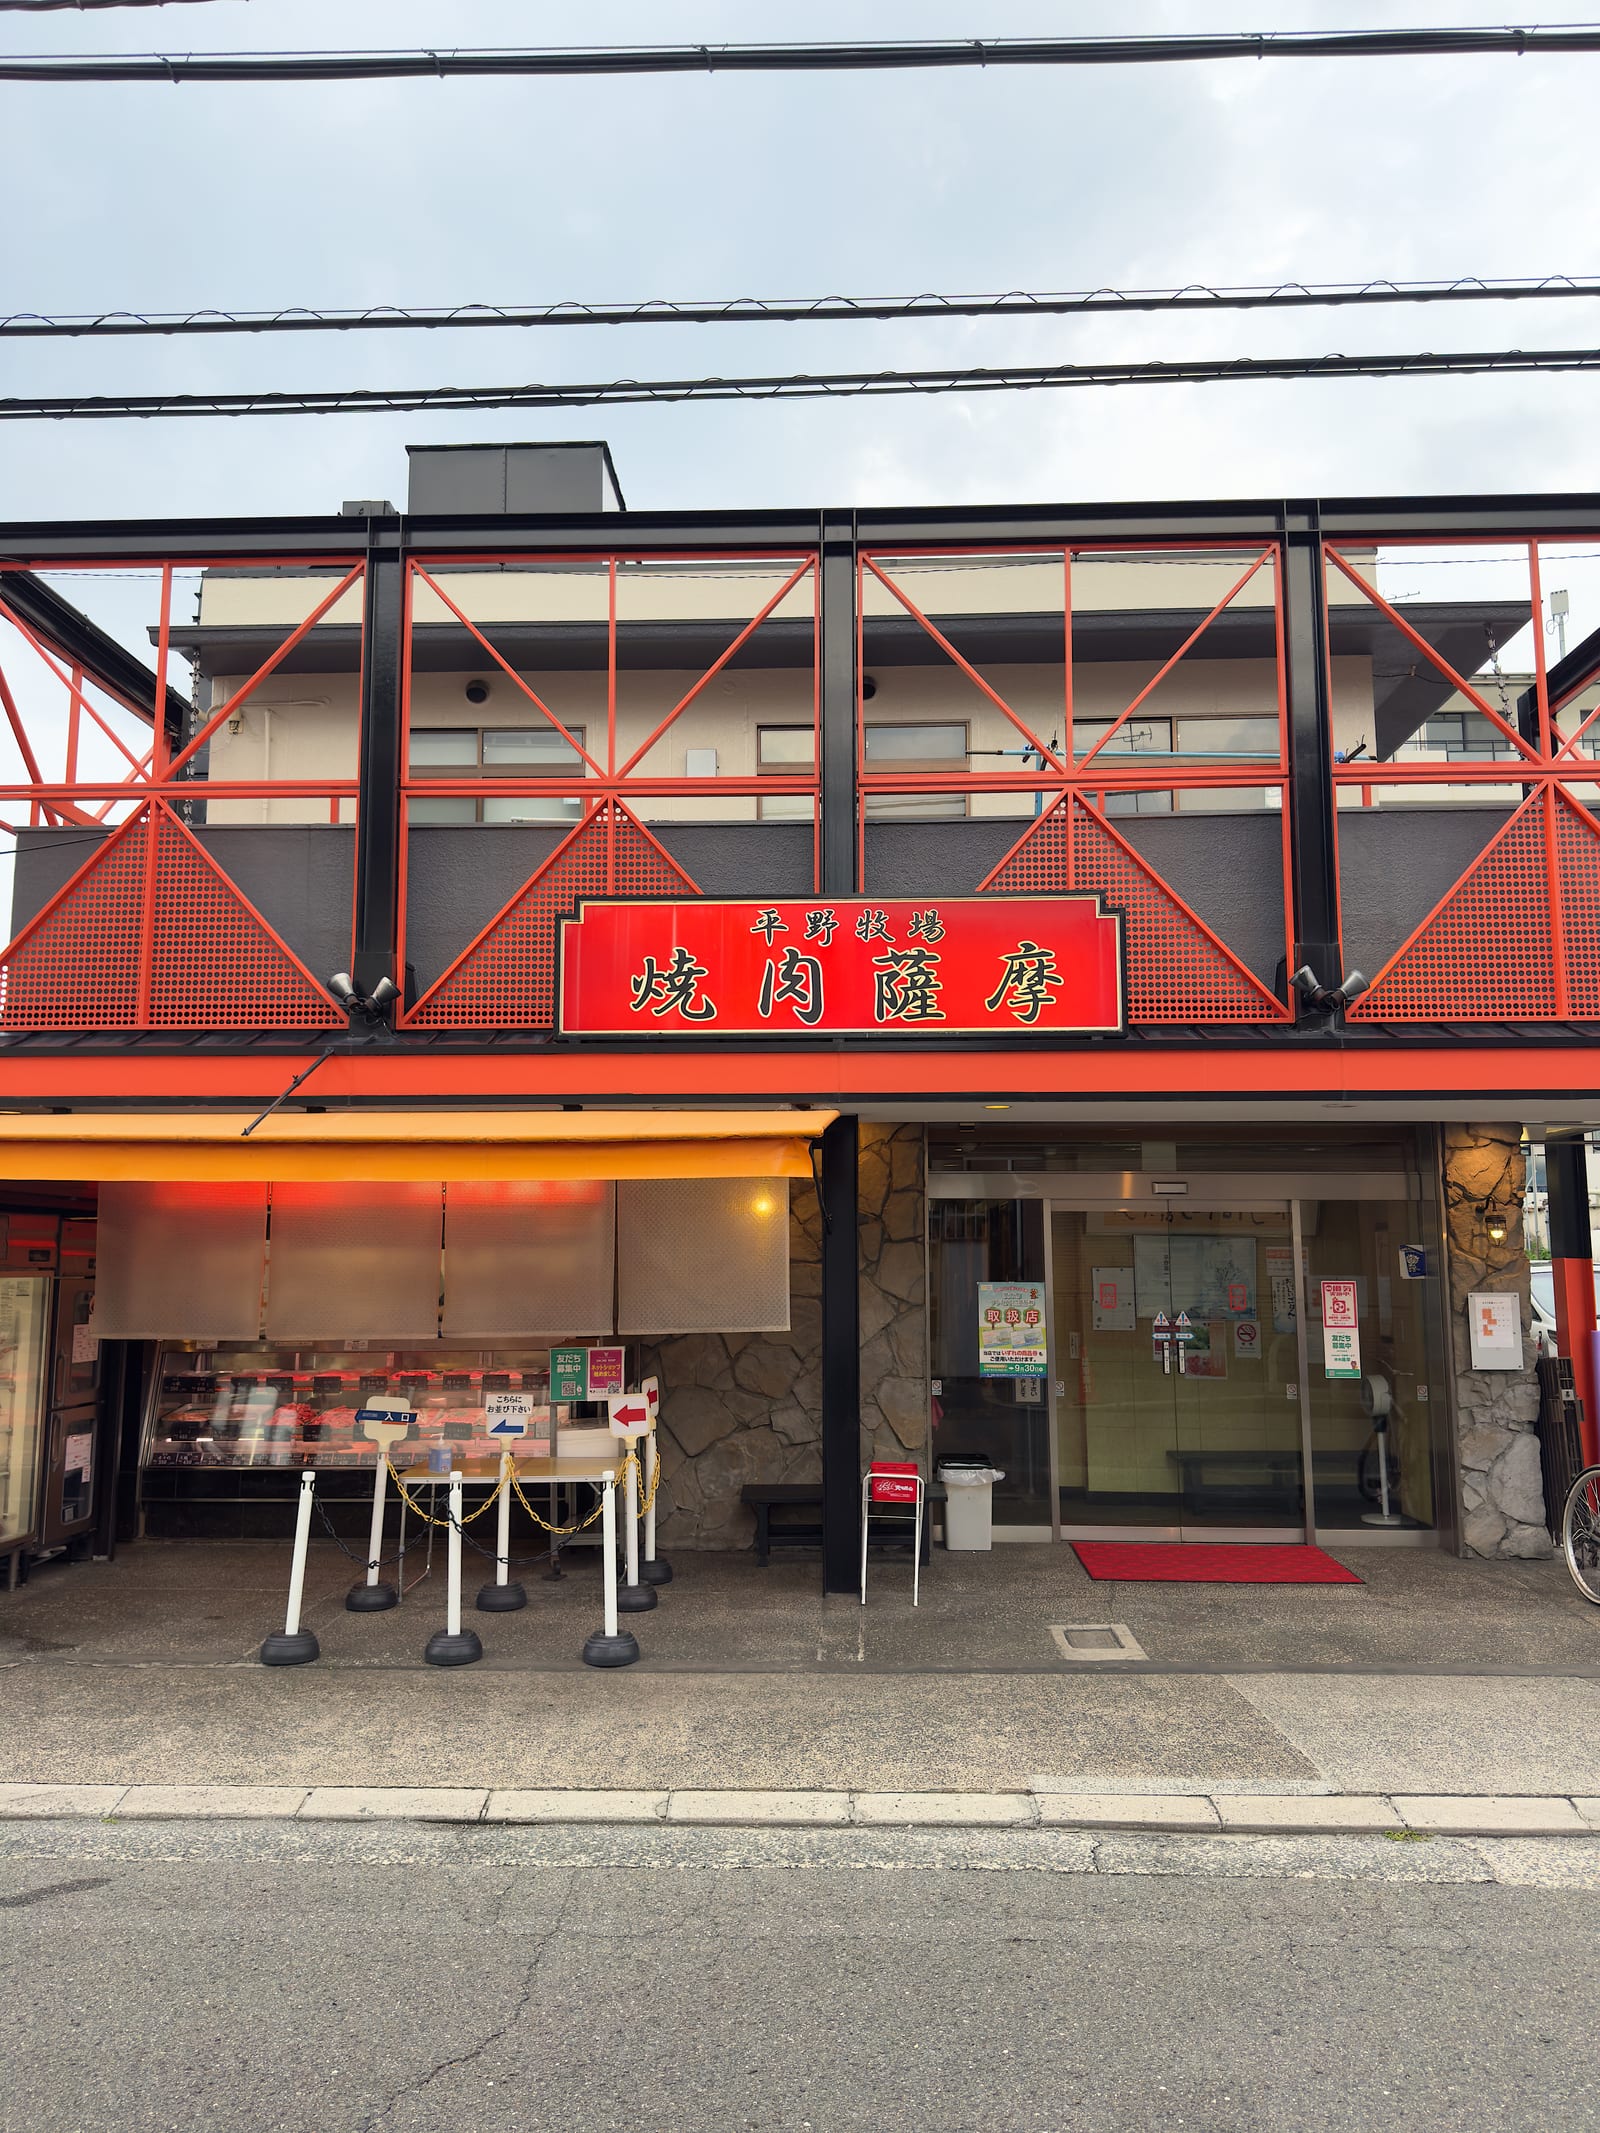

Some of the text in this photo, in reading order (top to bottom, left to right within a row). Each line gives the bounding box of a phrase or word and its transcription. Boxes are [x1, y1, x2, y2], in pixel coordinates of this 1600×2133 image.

[750, 908, 947, 947] 平野牧場
[629, 940, 1064, 1025] 焼肉薩摩
[987, 1310, 1039, 1323] 取扱店
[556, 1354, 582, 1363] 友だち
[497, 1396, 522, 1404] こちらに
[487, 1405, 531, 1414] お並び下さい
[384, 1412, 410, 1422] 入口
